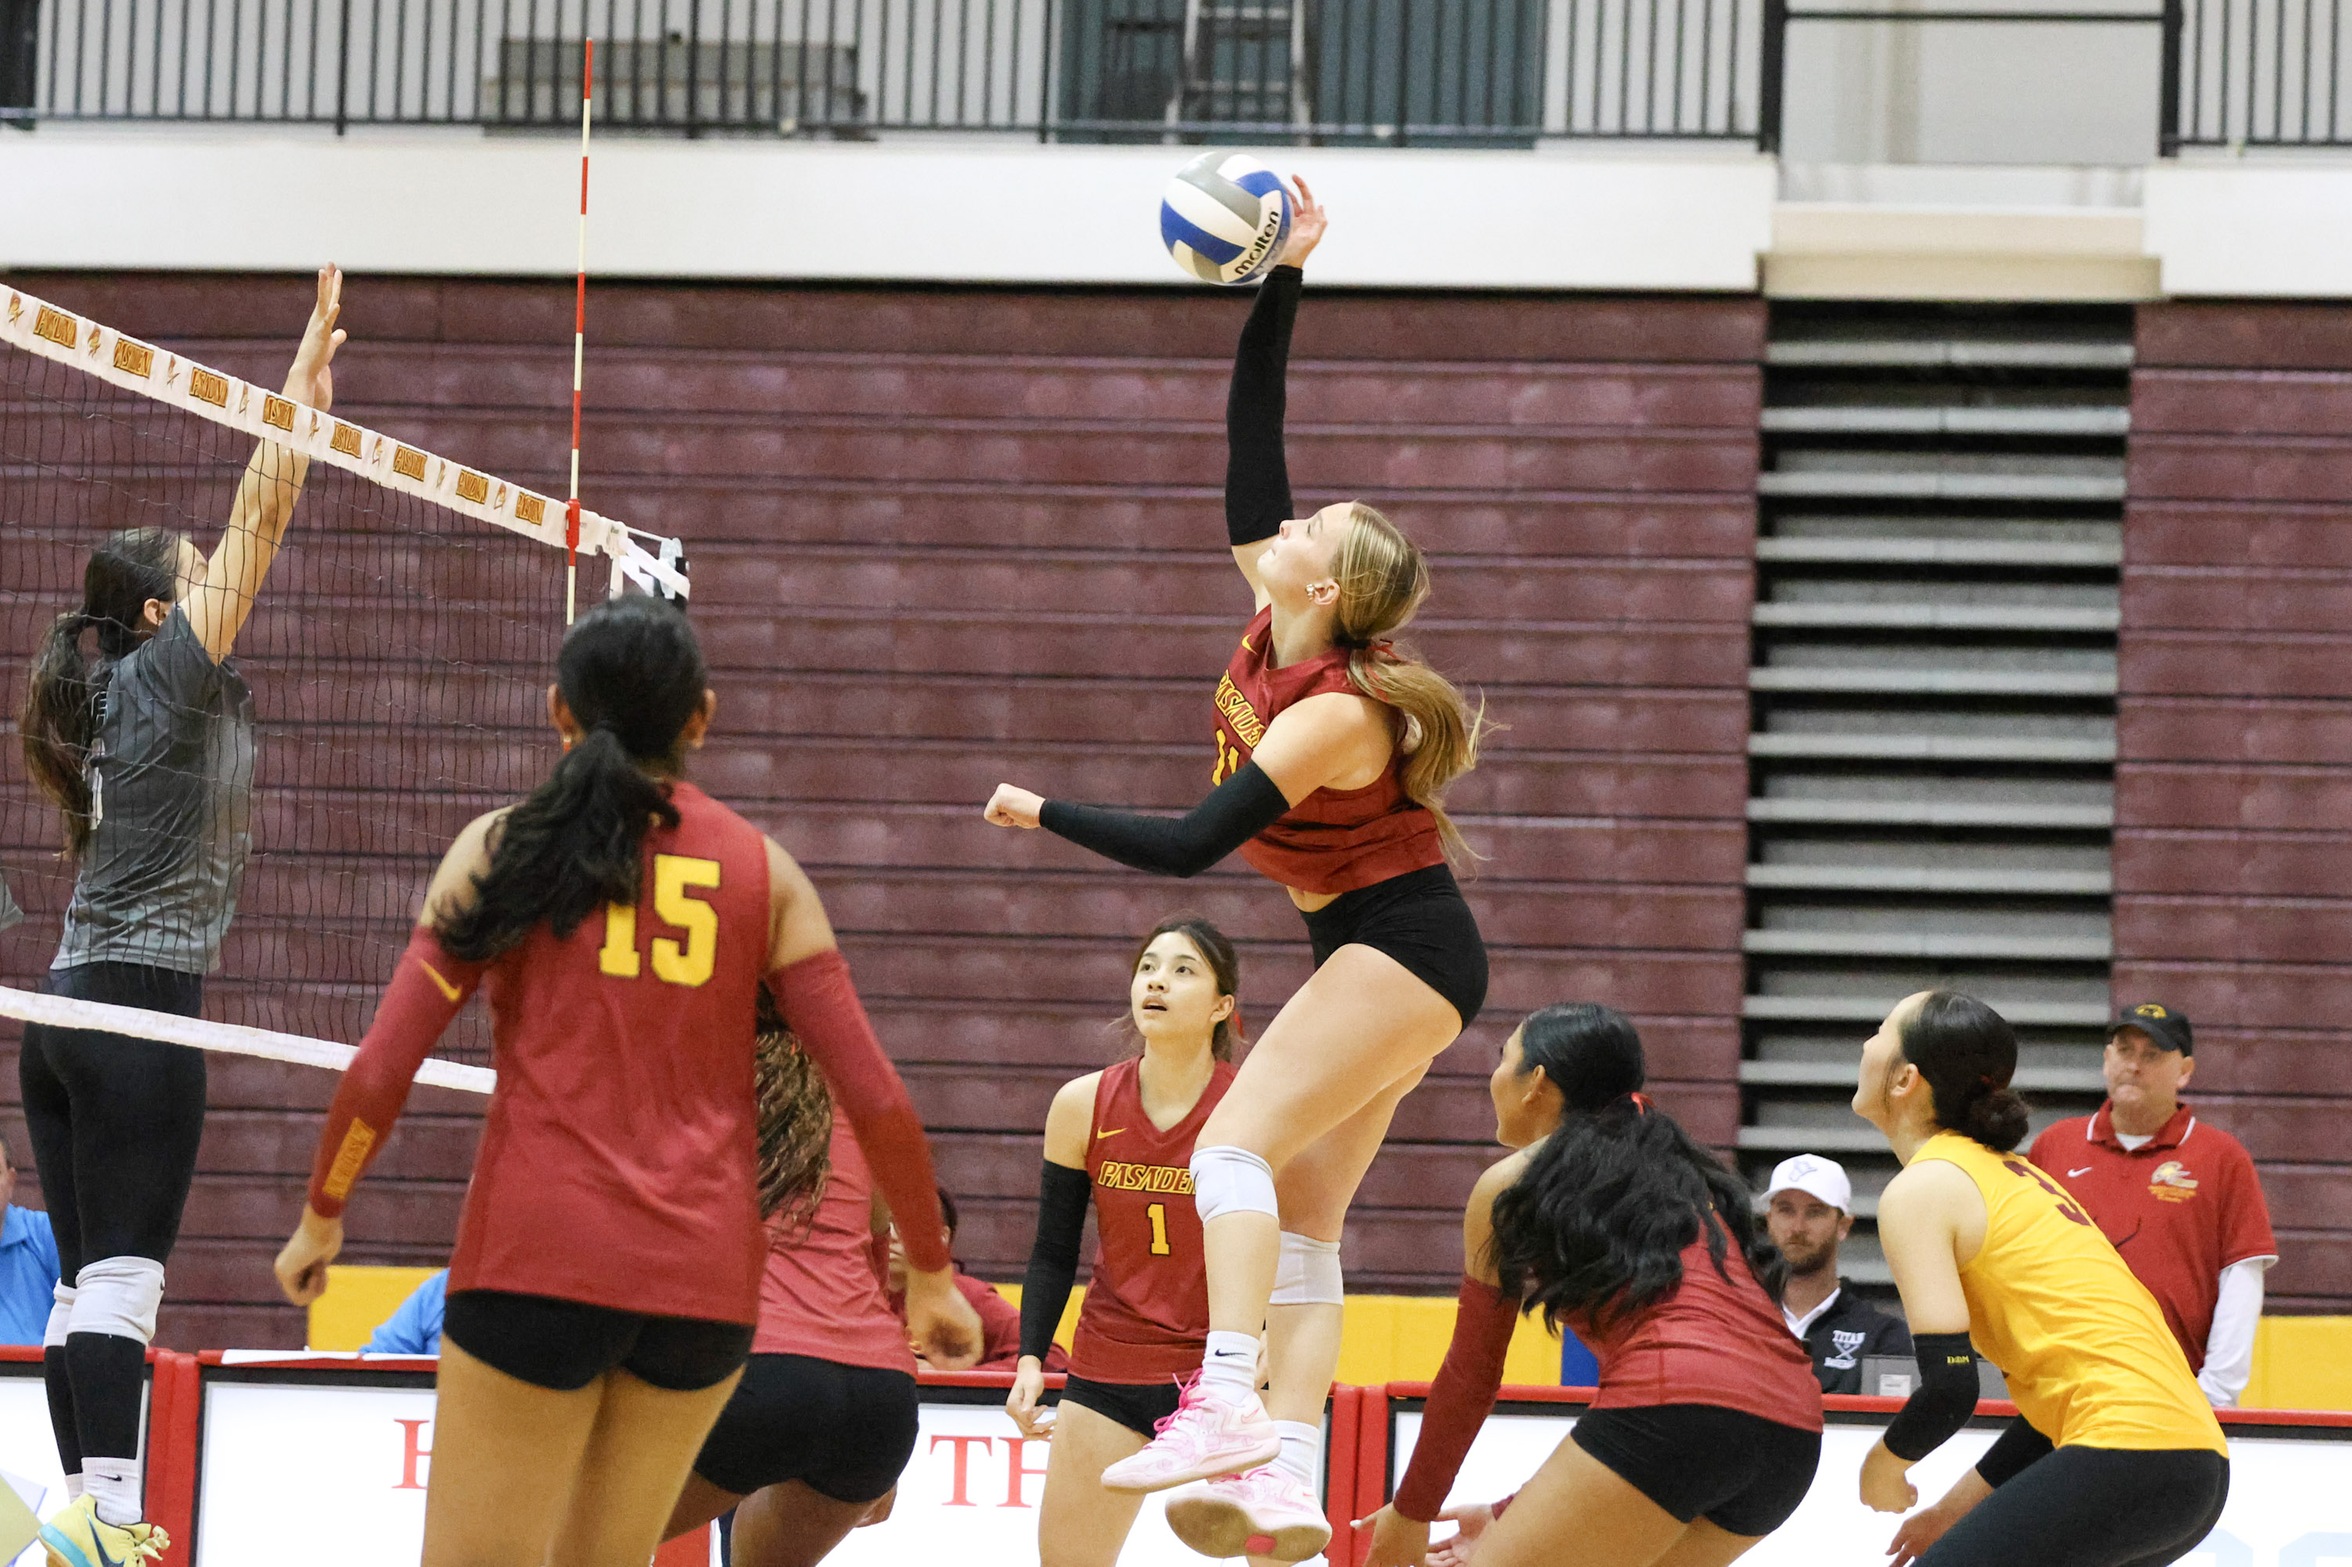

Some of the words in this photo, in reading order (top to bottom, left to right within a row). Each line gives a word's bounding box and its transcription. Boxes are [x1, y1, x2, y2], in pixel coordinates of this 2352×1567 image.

[1234, 211, 1279, 275] molten
[1214, 668, 1266, 748] PASADE
[599, 853, 720, 987] 15
[1098, 1161, 1196, 1195] PASADE
[1147, 1203, 1170, 1255] 1
